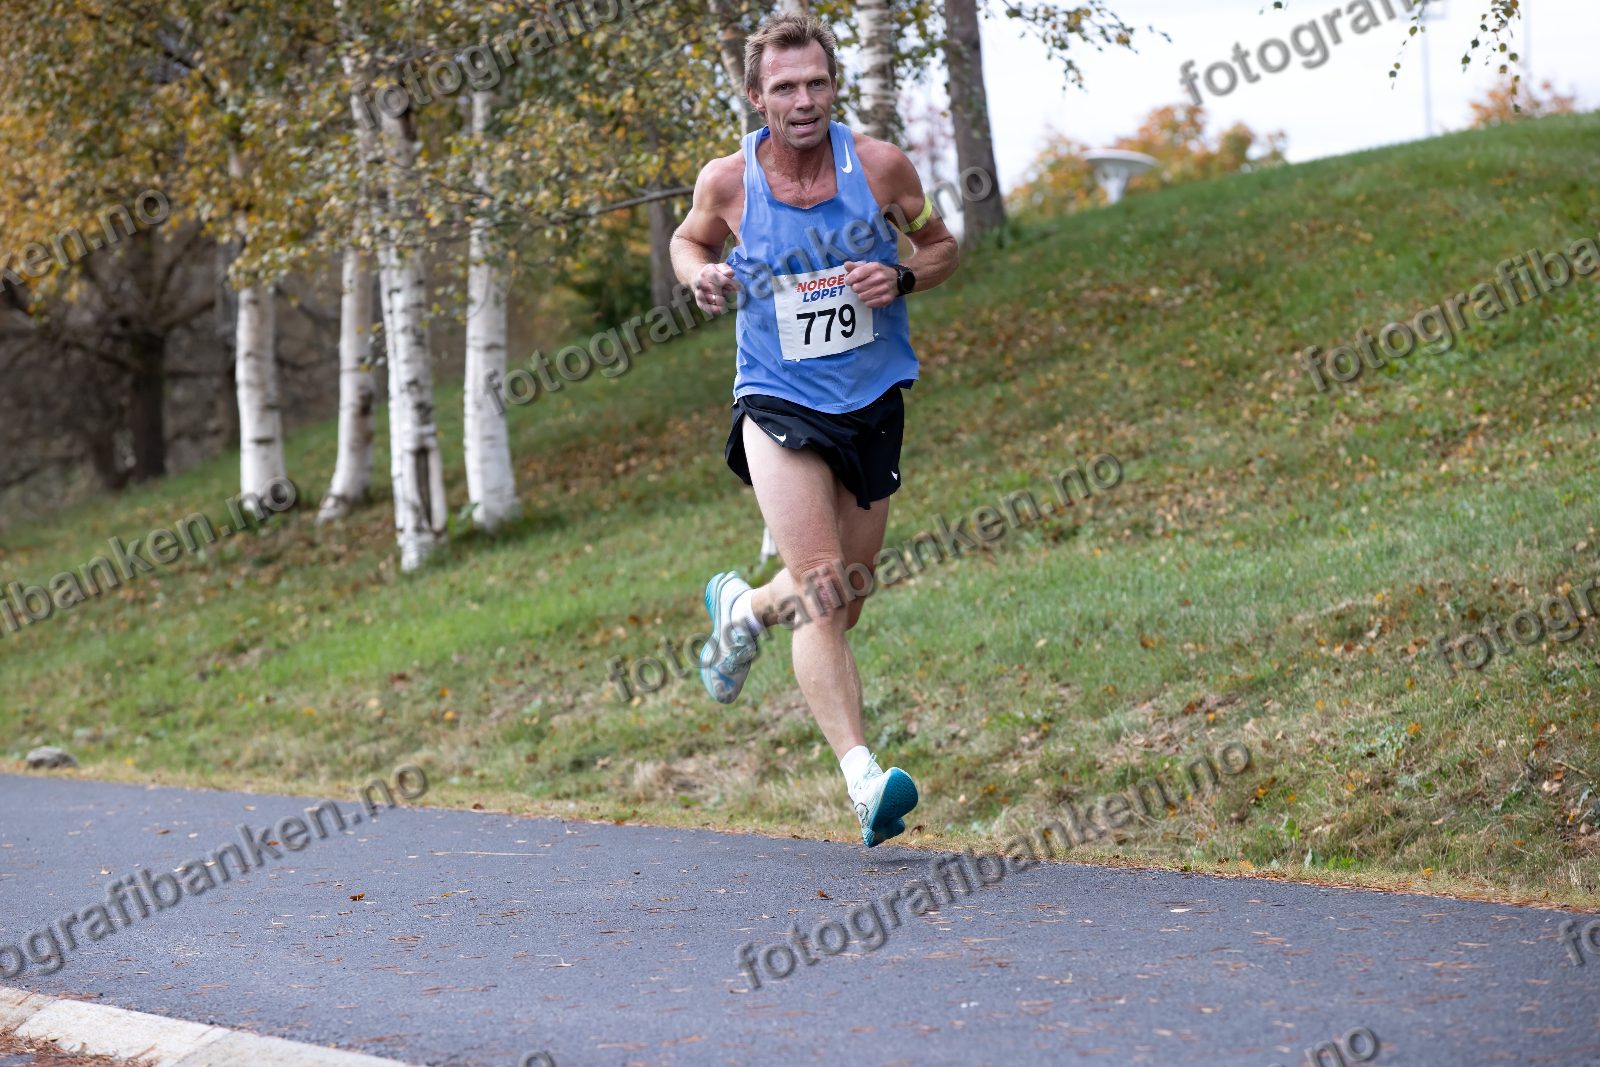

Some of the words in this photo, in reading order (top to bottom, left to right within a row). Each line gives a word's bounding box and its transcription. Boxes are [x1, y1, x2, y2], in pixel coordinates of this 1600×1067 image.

[796, 273, 845, 293] NORGE
[803, 285, 845, 302] LØPET
[796, 304, 856, 345] 779
